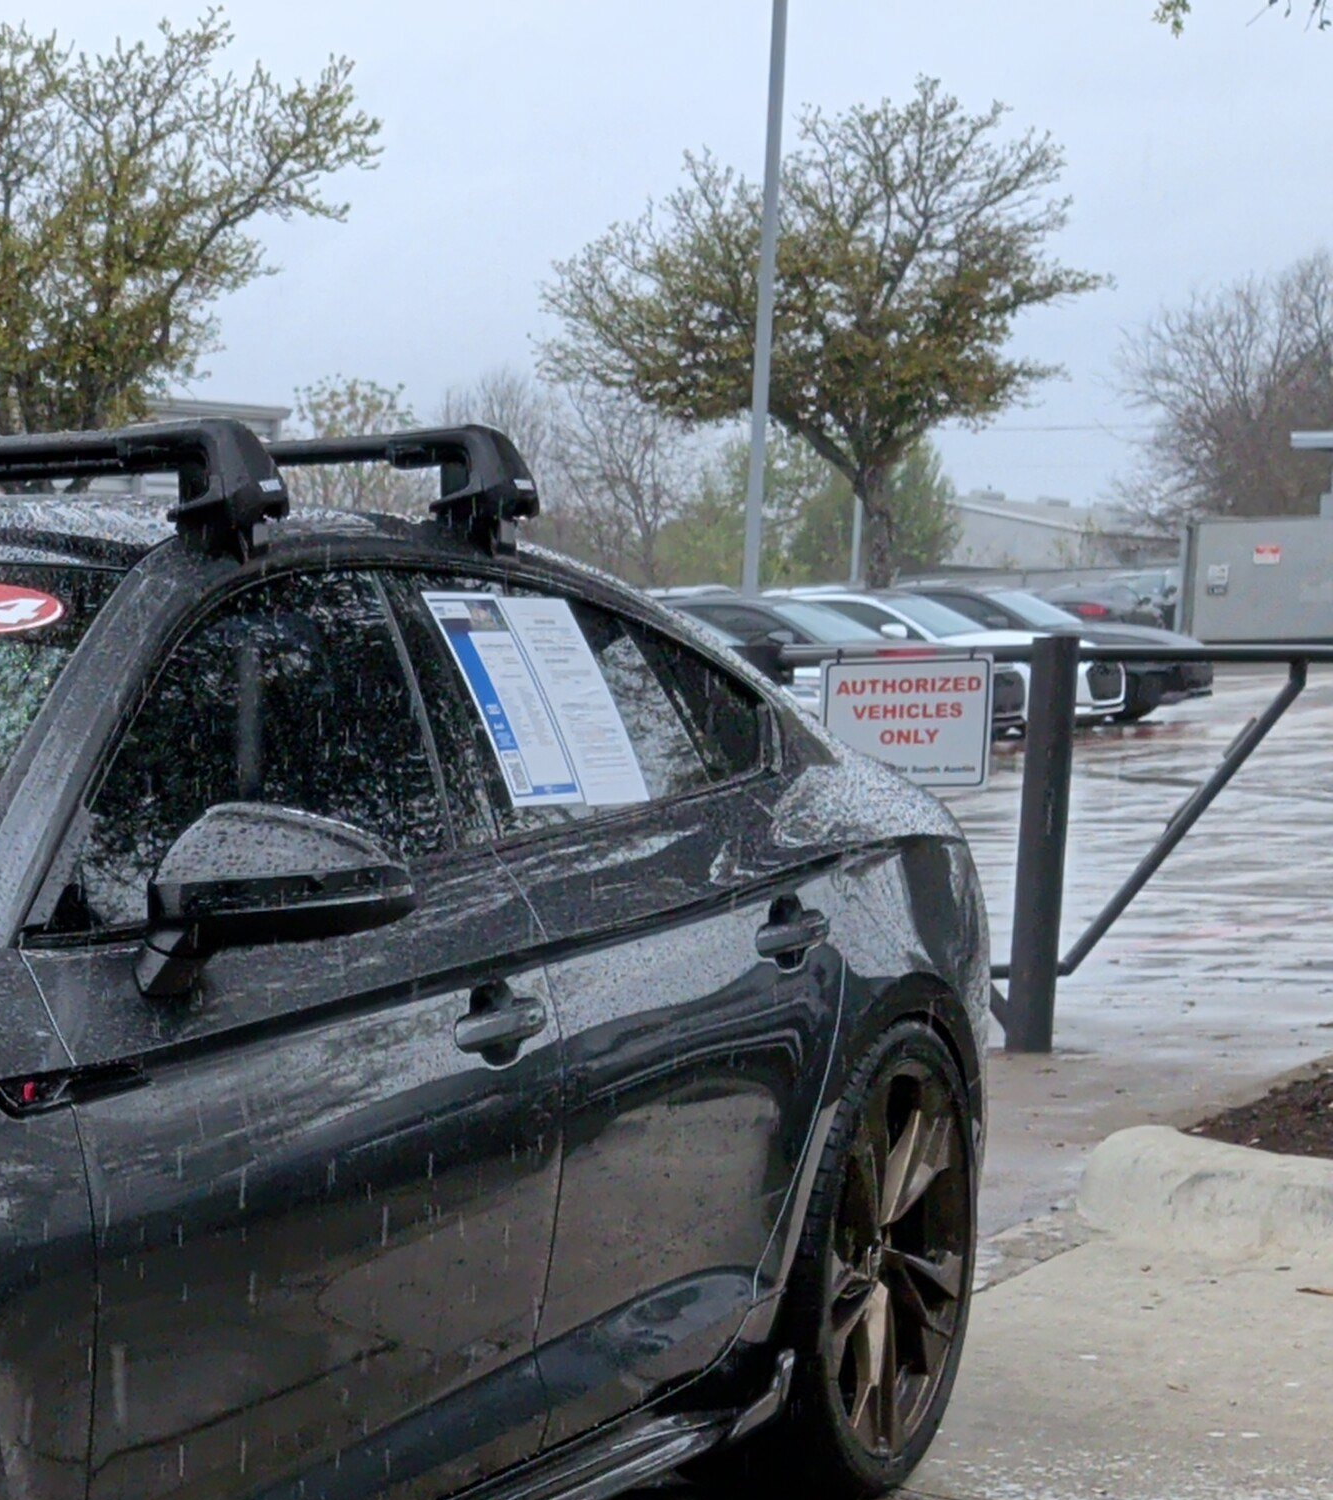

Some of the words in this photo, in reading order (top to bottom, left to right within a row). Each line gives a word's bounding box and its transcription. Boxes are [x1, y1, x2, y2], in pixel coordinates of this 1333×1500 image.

[837, 676, 982, 696] AUTHORIZED
[853, 702, 962, 720] VEHICLES
[879, 728, 939, 745] ONLY
